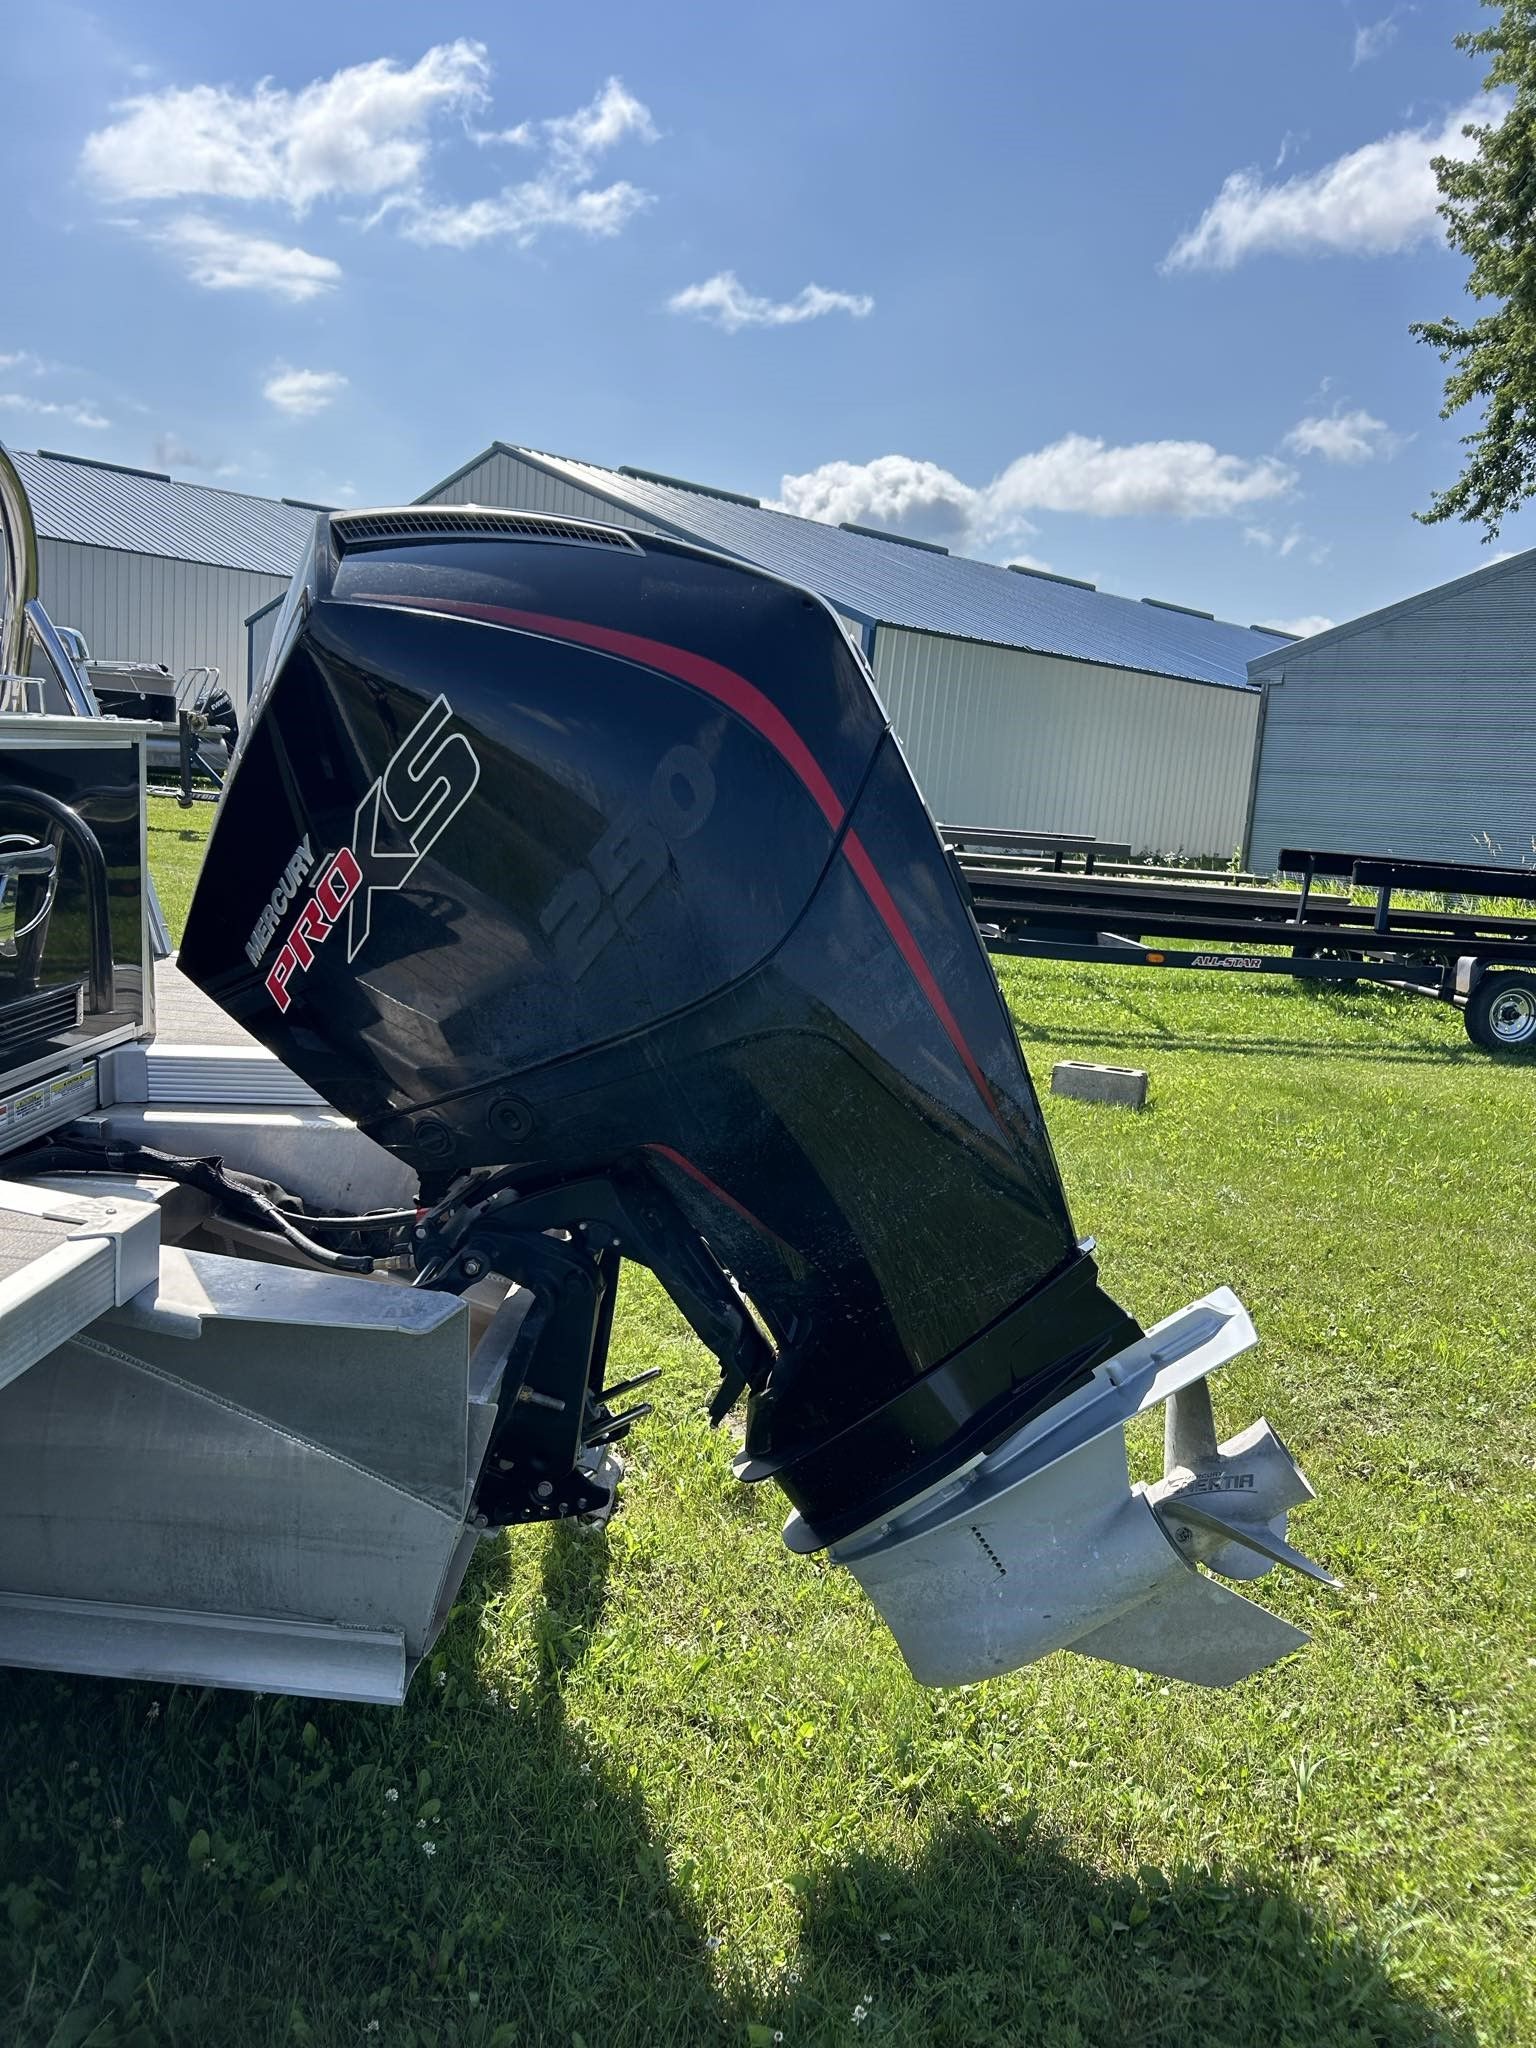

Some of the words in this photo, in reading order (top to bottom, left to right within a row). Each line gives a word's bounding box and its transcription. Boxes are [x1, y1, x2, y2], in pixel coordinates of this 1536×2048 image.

[244, 832, 316, 968] MERCURY
[264, 846, 364, 1015] PRO
[347, 692, 481, 964] XS
[538, 744, 717, 985] 250
[1191, 955, 1262, 969] ALL-STAR
